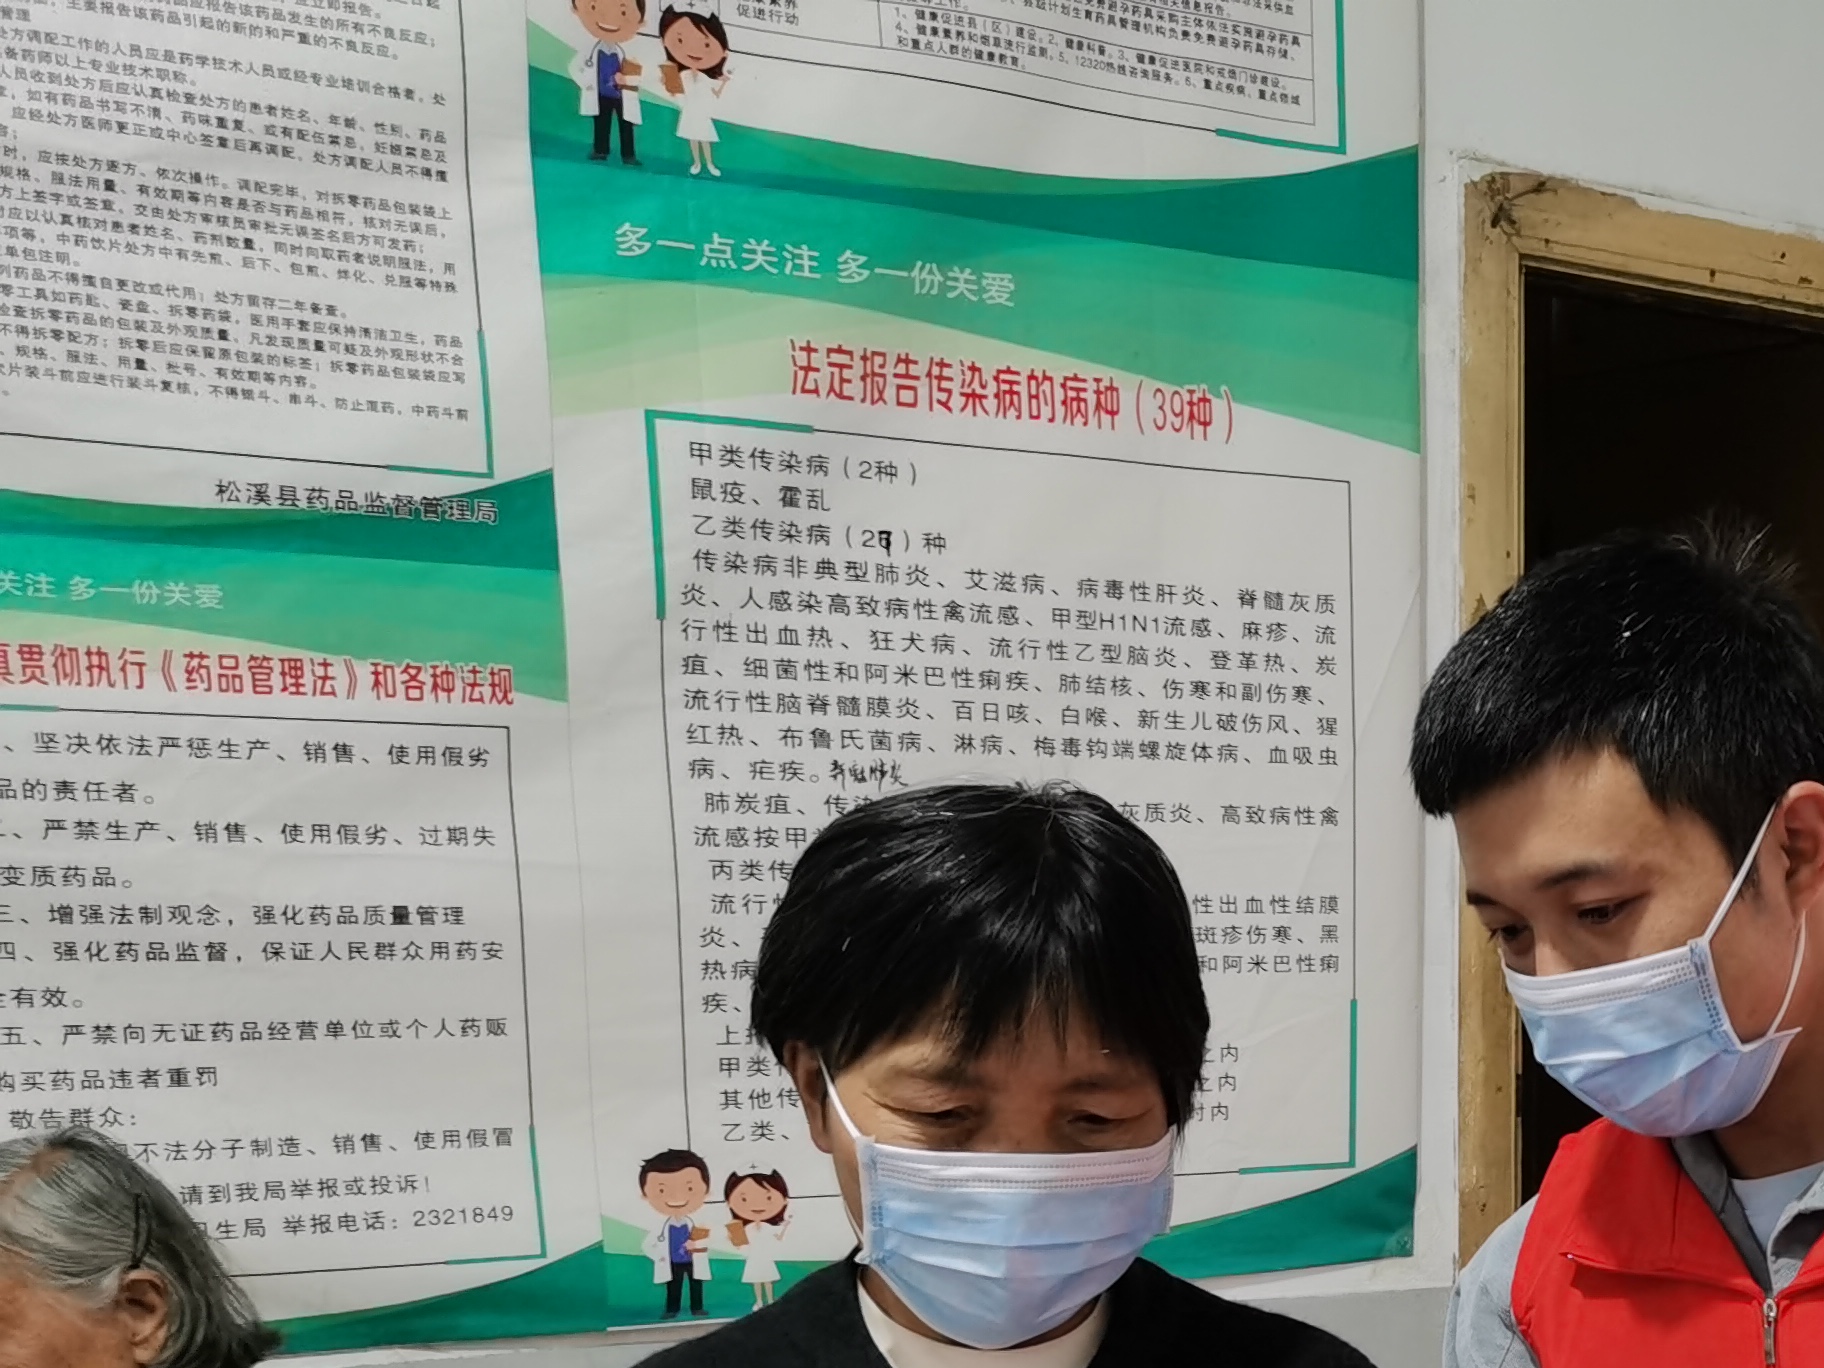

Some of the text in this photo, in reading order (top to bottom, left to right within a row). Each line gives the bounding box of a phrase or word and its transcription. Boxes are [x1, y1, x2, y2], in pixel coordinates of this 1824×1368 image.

[614, 221, 1017, 308] 多一点关注 多一份关爱
[215, 479, 499, 525] 松溪县药品监督管理局
[690, 476, 831, 513] 鼠疫、霍乱
[68, 574, 225, 611] 多一份关爱
[687, 758, 820, 784] 病、疟疾。
[693, 825, 823, 850] 流感按甲
[1192, 893, 1341, 916] 性出血性结膜
